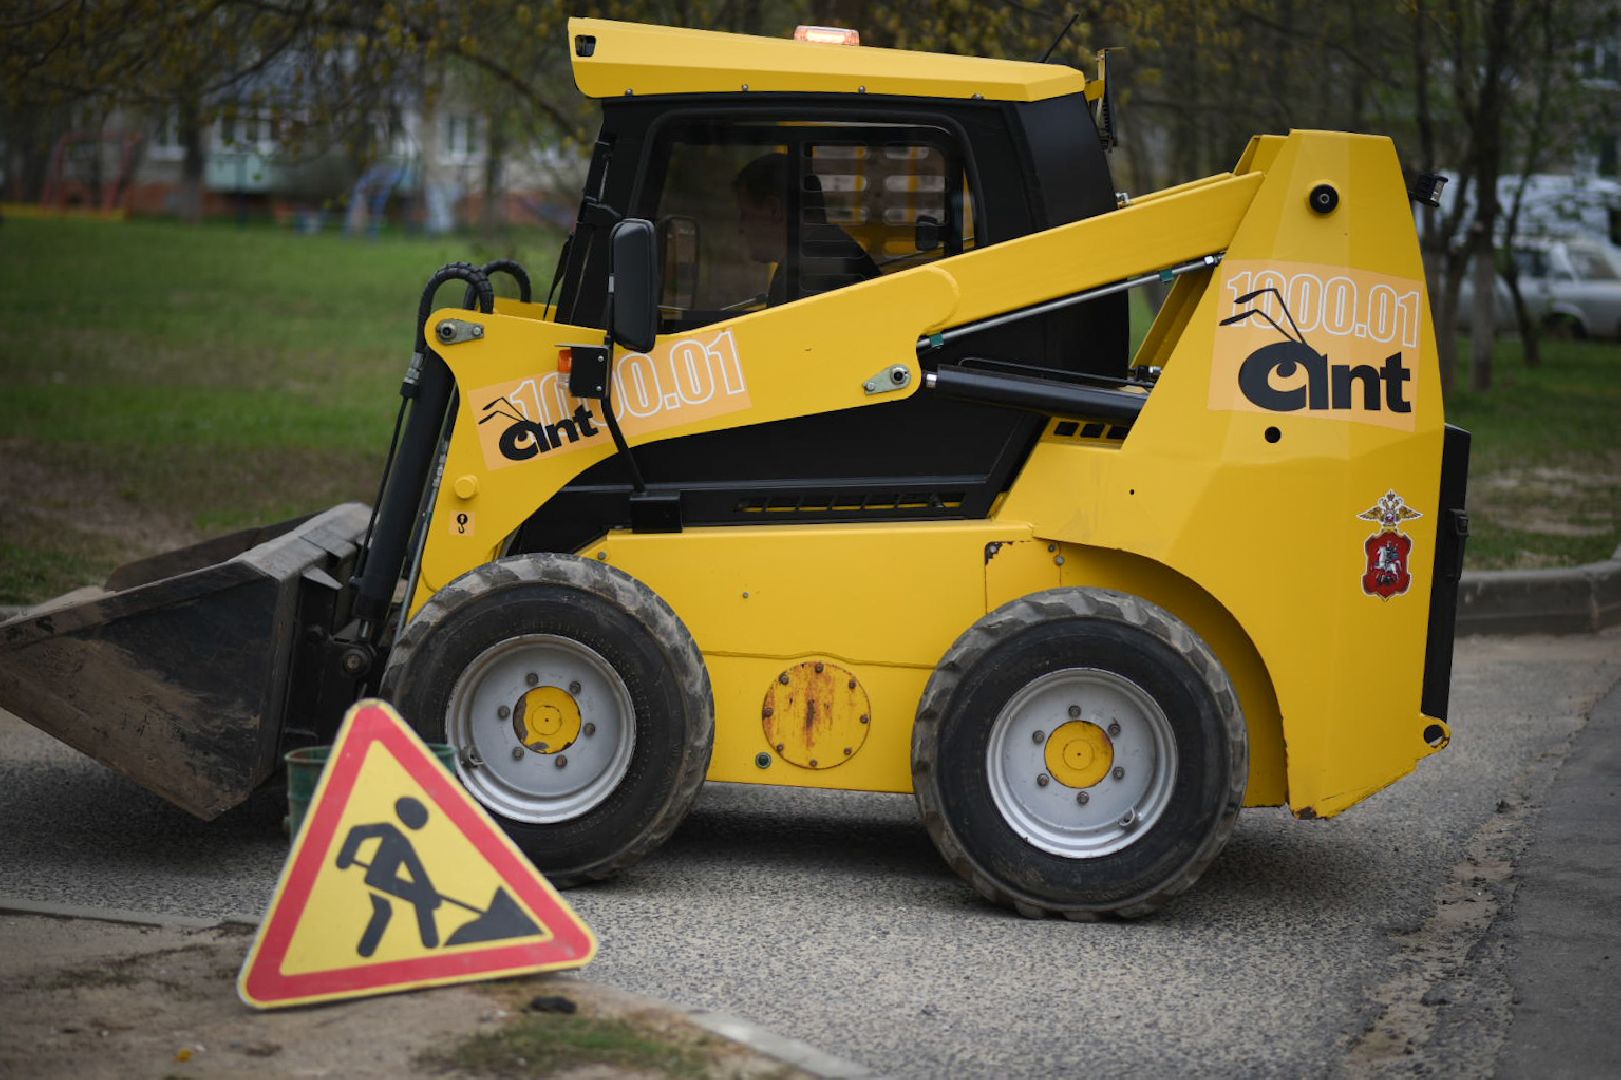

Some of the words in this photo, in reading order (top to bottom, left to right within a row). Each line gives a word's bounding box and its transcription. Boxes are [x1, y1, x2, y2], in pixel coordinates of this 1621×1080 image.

[1227, 270, 1420, 348] 1000.01
[1238, 341, 1411, 413] ant
[498, 404, 599, 461] ant
